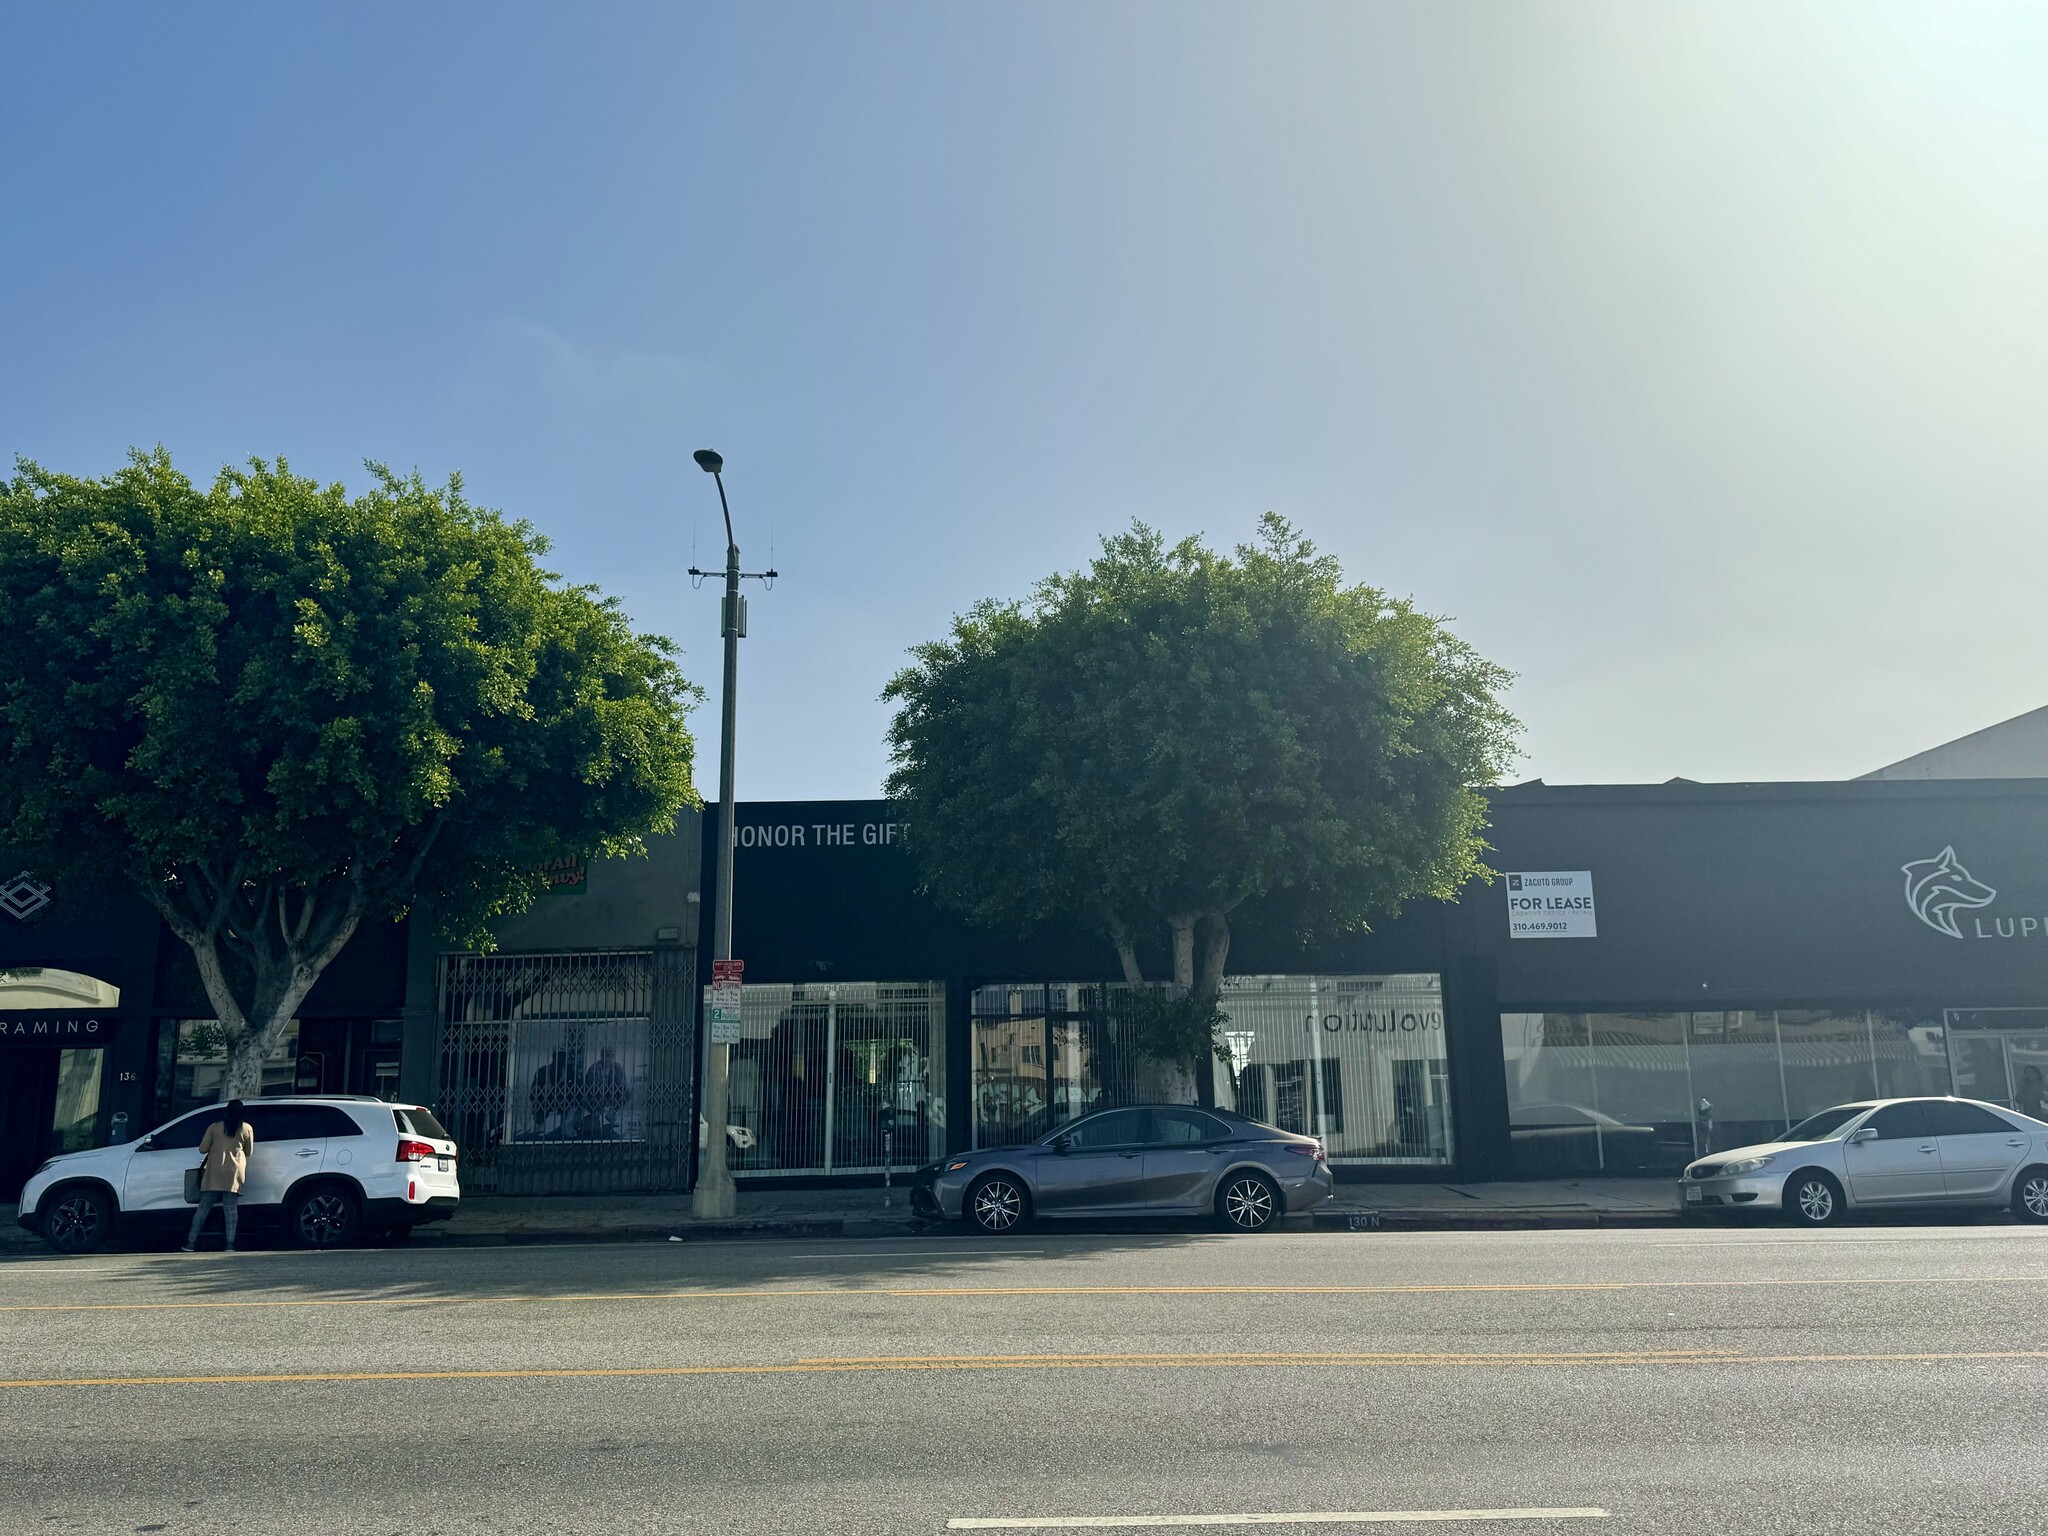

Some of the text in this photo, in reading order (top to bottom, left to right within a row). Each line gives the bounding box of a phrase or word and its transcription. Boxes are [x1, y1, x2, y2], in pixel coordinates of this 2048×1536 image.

[812, 824, 855, 845] THE
[1524, 878, 1573, 886] ZACUTO GROUP
[1511, 897, 1592, 910] FOR LEASE
[1513, 922, 1567, 931] 310.469.9012
[713, 981, 722, 990] NO
[714, 1010, 720, 1019] 2
[0, 1020, 98, 1034] RAMING
[120, 1072, 136, 1081] 136
[1349, 1217, 1380, 1227] 130 N
